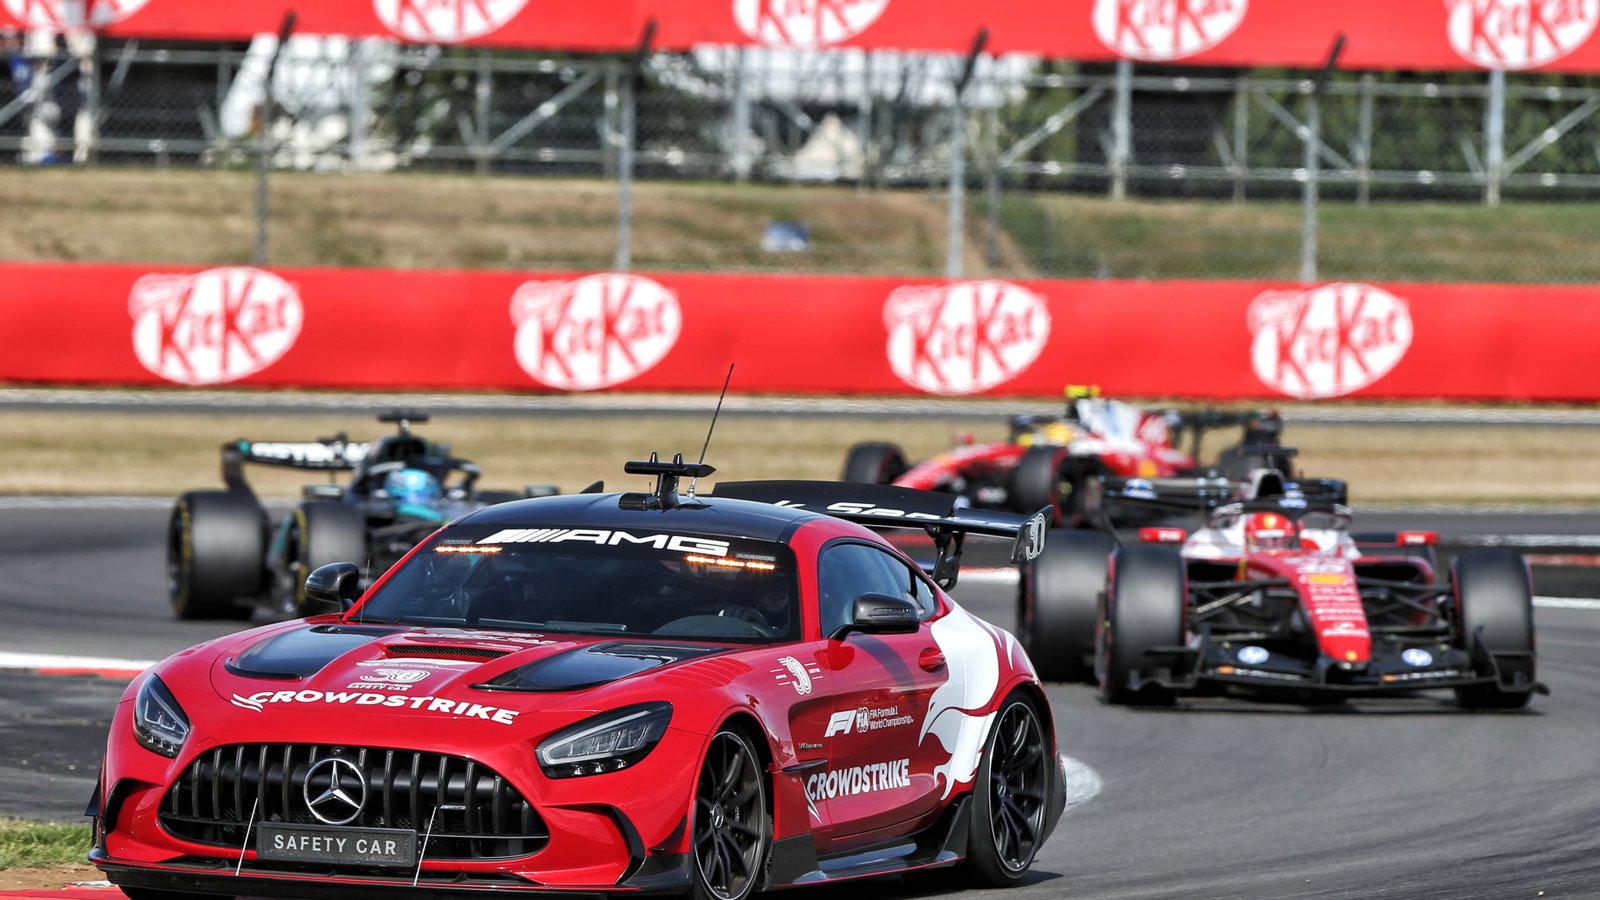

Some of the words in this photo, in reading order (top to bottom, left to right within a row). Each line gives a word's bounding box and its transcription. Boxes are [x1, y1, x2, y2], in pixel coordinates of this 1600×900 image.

[158, 270, 292, 378] KitKat
[539, 280, 666, 380] KitKat
[912, 284, 1036, 386] KitKat
[1275, 291, 1397, 388] KitKat
[556, 529, 730, 557] AMG
[1025, 513, 1046, 561] 30
[249, 690, 520, 725] CROWDSTRIKE
[824, 710, 857, 738] F1
[869, 719, 884, 730] World
[878, 707, 895, 717] Formula
[806, 758, 911, 801] CROWDSTRIKE
[274, 834, 347, 853] SAFETY
[356, 838, 396, 856] CAR
